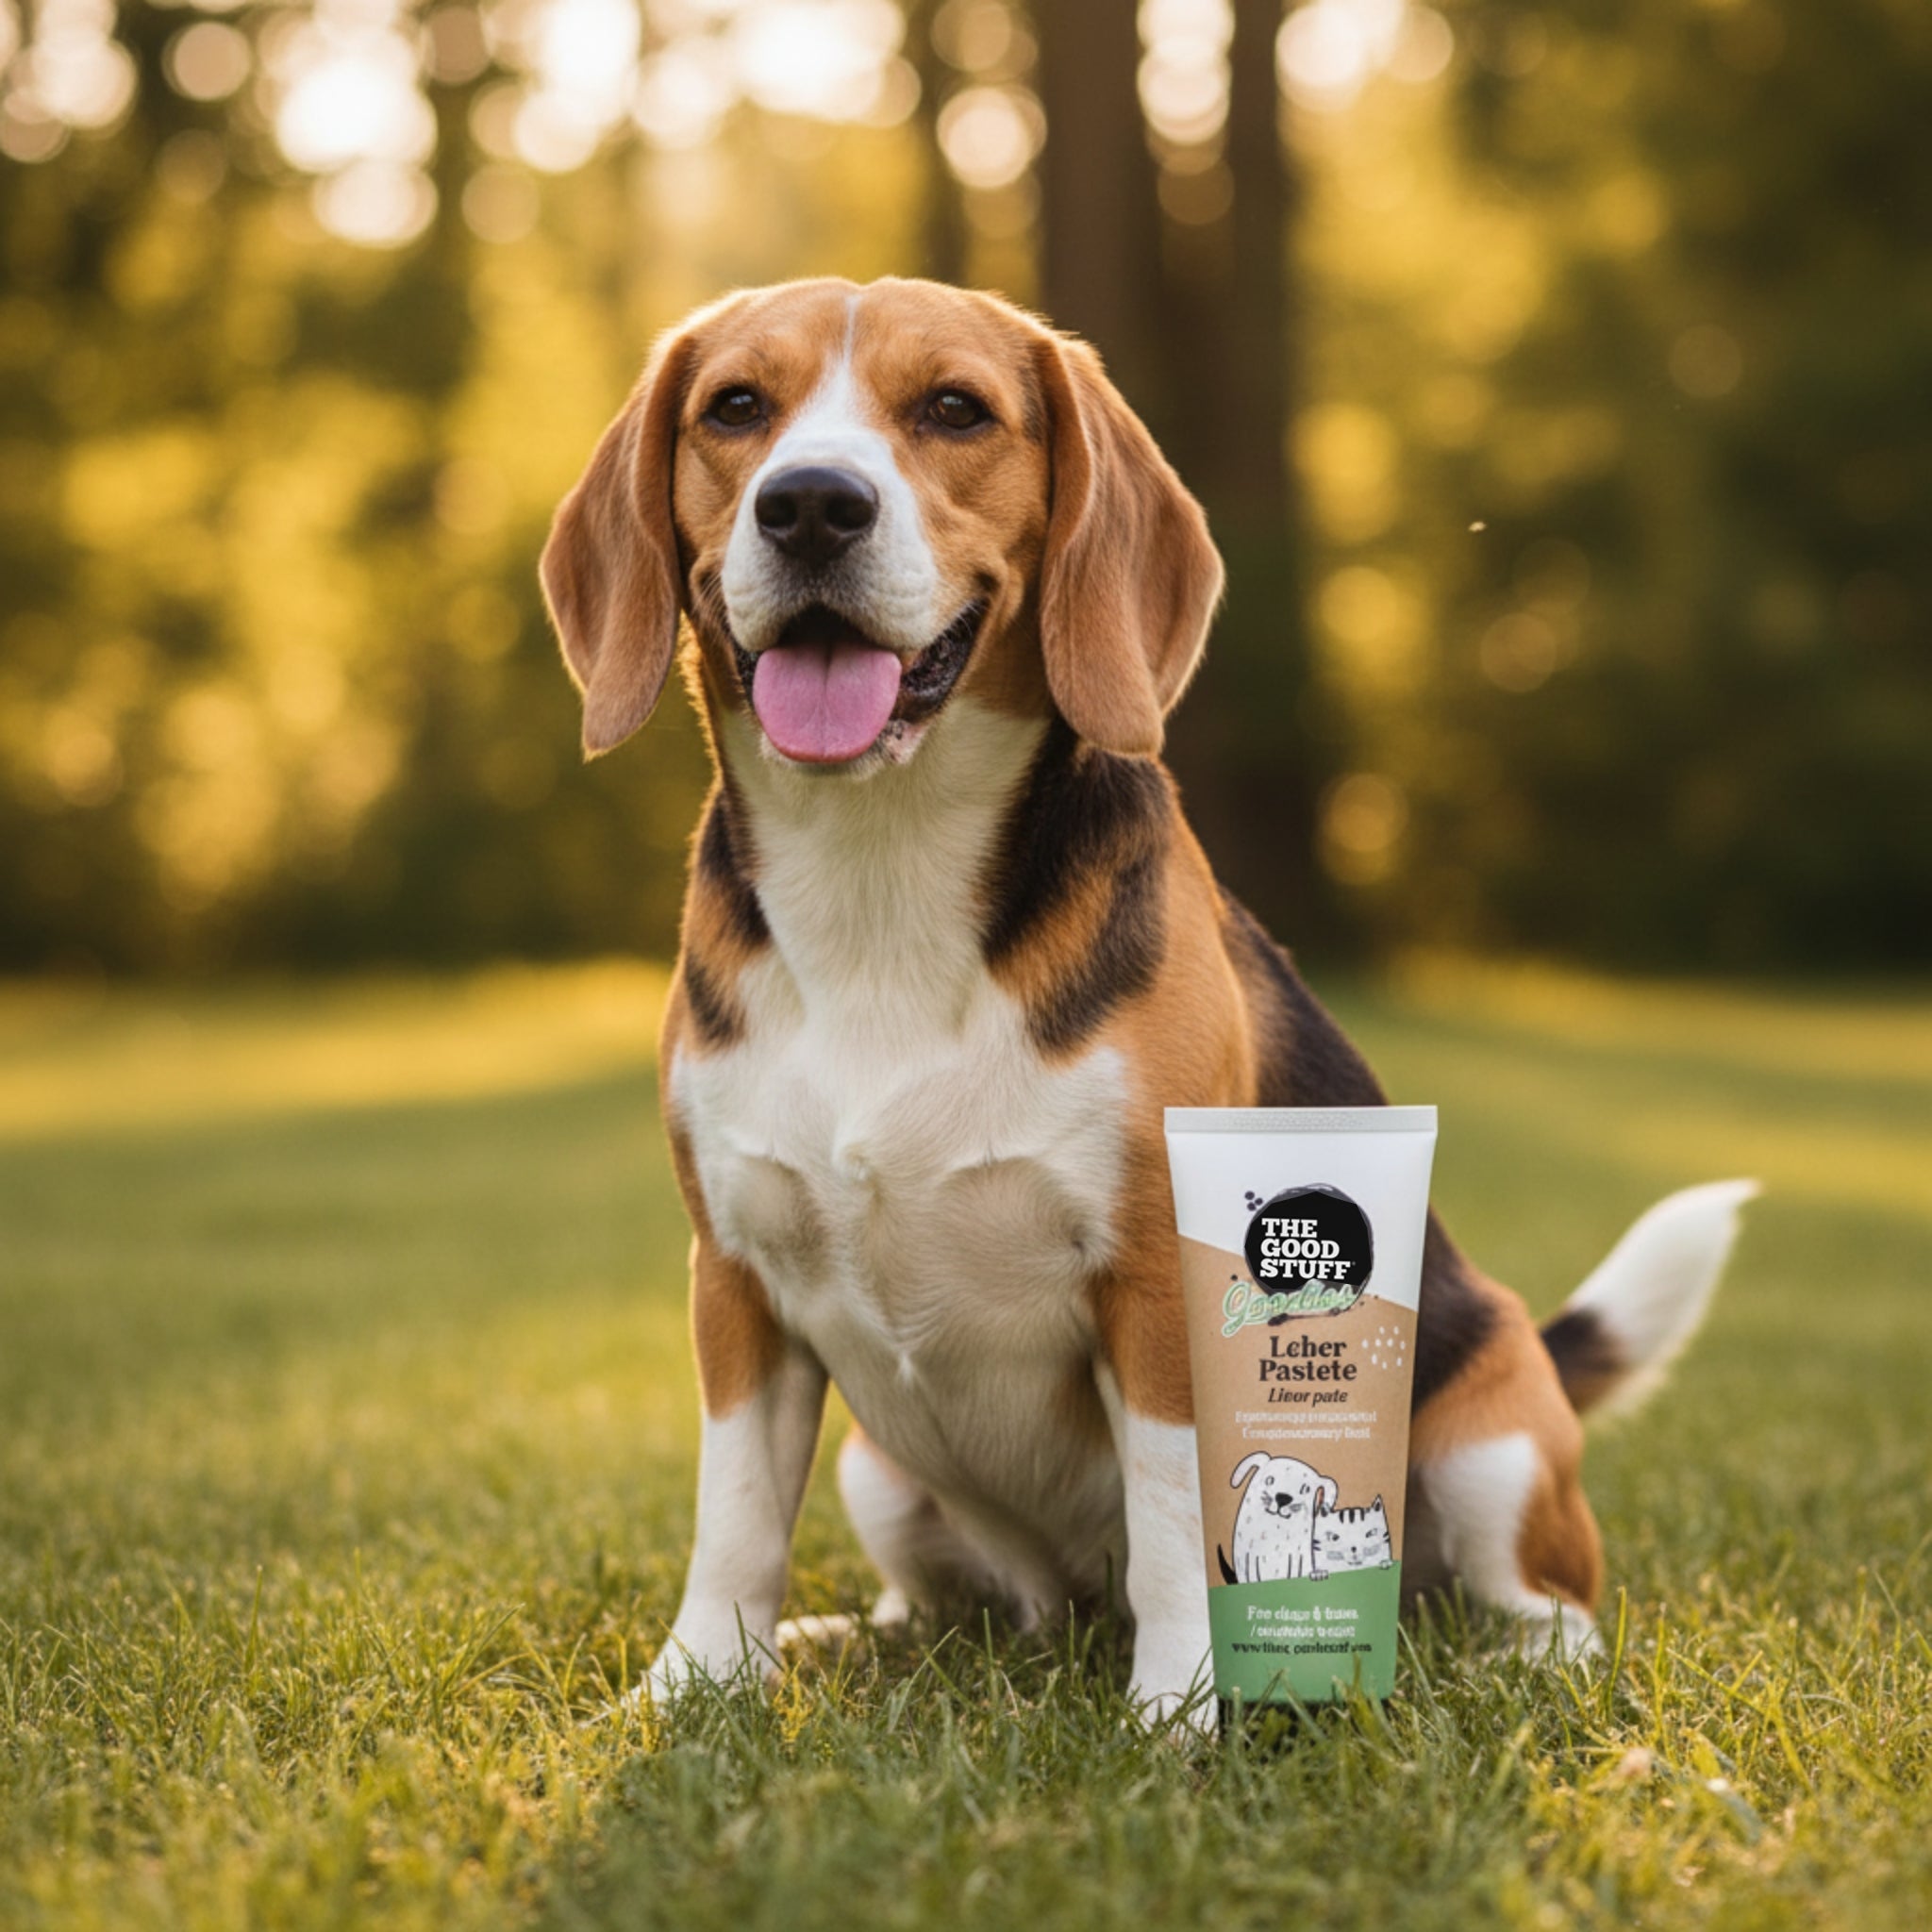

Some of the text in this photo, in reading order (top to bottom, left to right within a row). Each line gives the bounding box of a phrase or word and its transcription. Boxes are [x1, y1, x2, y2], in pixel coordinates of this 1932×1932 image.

[1261, 1218, 1318, 1238] THE
[1260, 1239, 1341, 1259] GOOD
[1259, 1258, 1351, 1280] STUFF
[1258, 1358, 1357, 1382] Pastete
